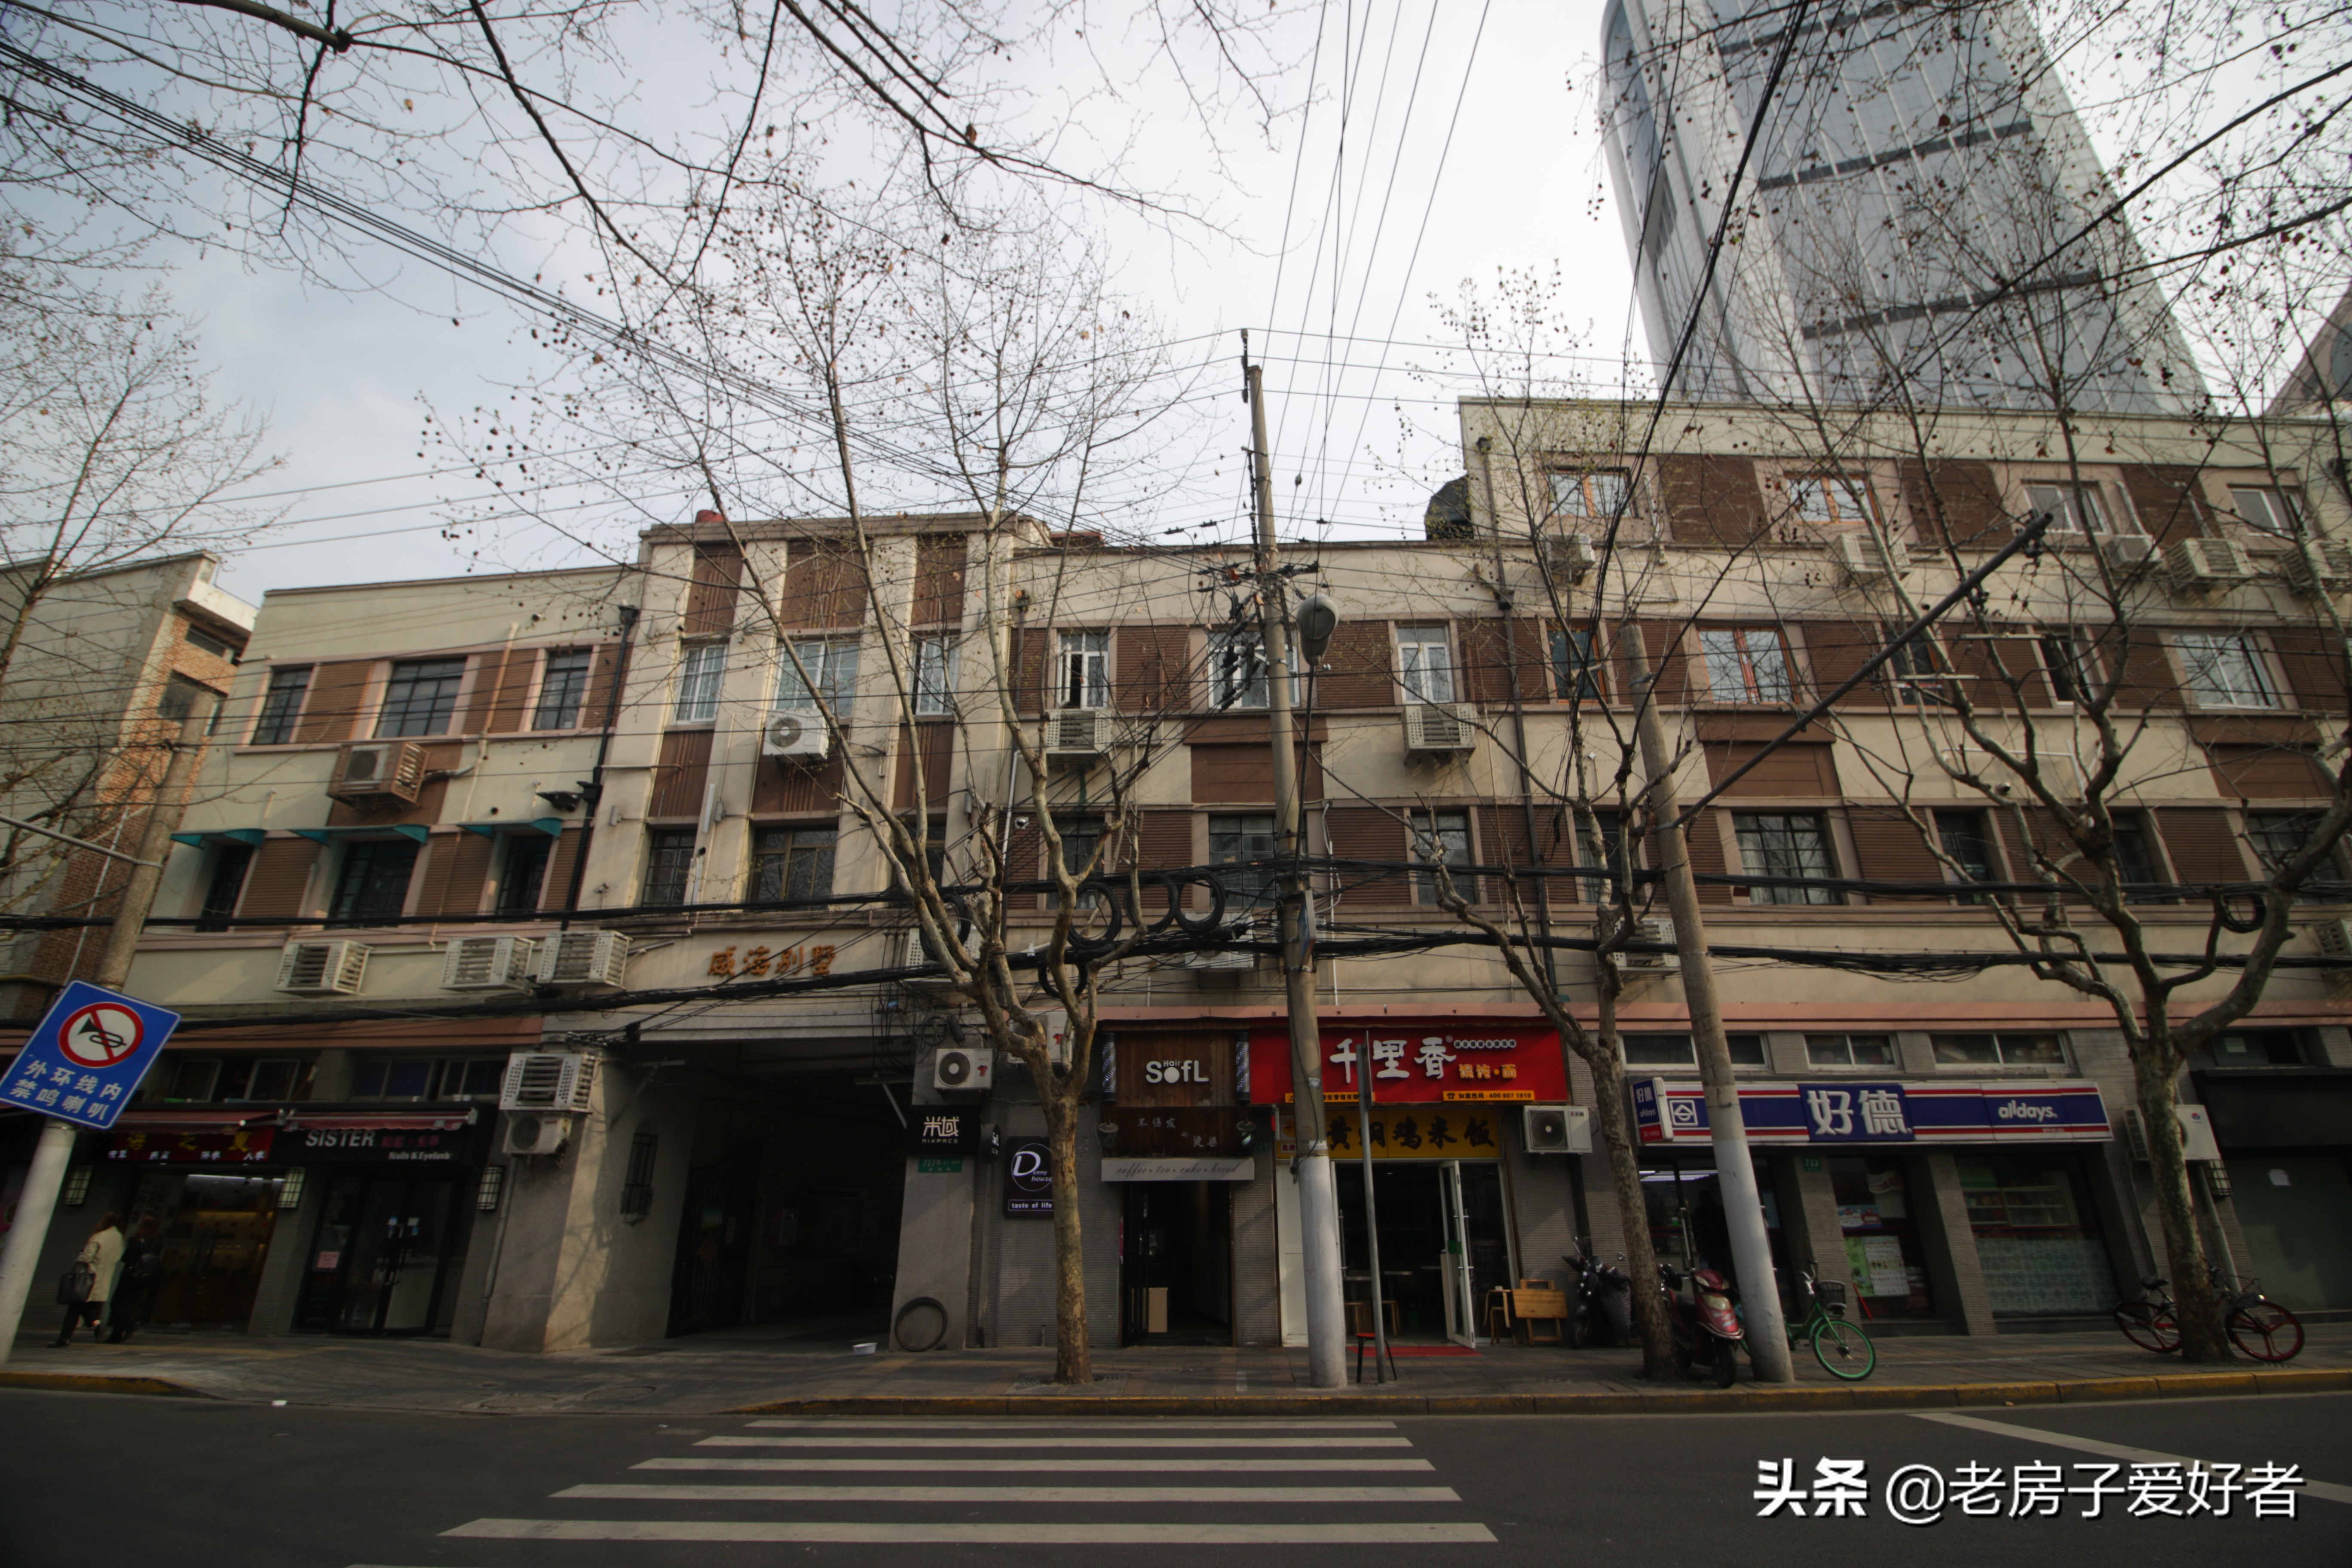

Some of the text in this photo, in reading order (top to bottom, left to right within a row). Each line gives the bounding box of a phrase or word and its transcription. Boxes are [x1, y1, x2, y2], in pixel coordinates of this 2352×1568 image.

[707, 944, 837, 977] 威海别墅
[1329, 1036, 1457, 1084] 千里香
[23, 1060, 123, 1101] 外环线内
[9, 1078, 110, 1121] 禁鸣喇叭
[1636, 1087, 1654, 1103] 好德
[1137, 1117, 1176, 1129] 不伤发
[1807, 1089, 1908, 1135] 好德
[1997, 1100, 2054, 1122] alldays
[305, 1129, 376, 1147] SISTER
[1192, 1135, 1218, 1148] 烫染
[1327, 1116, 1495, 1150] 黄焖鸡米饭
[1116, 1162, 1241, 1178] coffee tea cake bread
